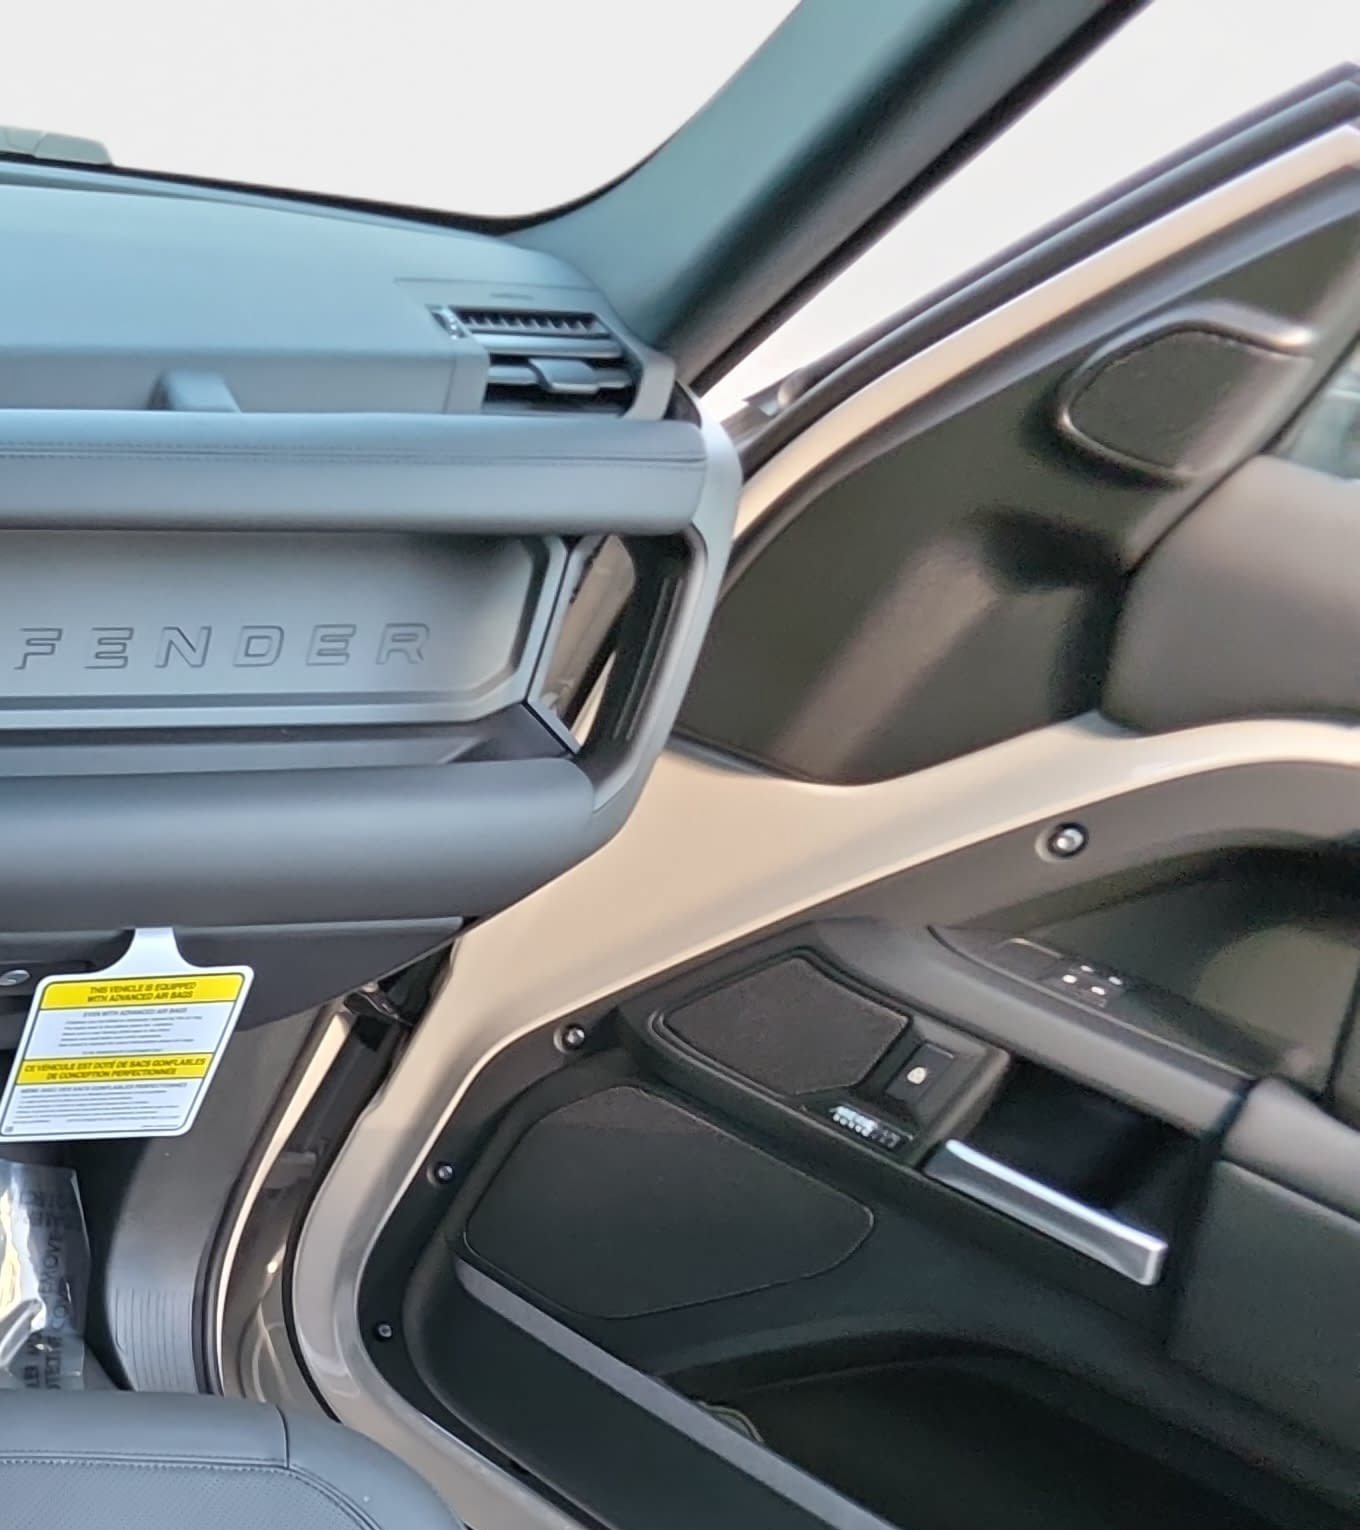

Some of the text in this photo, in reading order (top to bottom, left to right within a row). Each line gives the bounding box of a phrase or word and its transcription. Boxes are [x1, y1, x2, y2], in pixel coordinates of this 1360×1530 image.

[90, 986, 108, 995] THIS
[110, 984, 144, 994] VEHICLE
[154, 981, 197, 992] EQUIPPED
[87, 994, 108, 1003] WITH
[109, 993, 153, 1003] ADVANCED
[154, 992, 169, 1001] AIR
